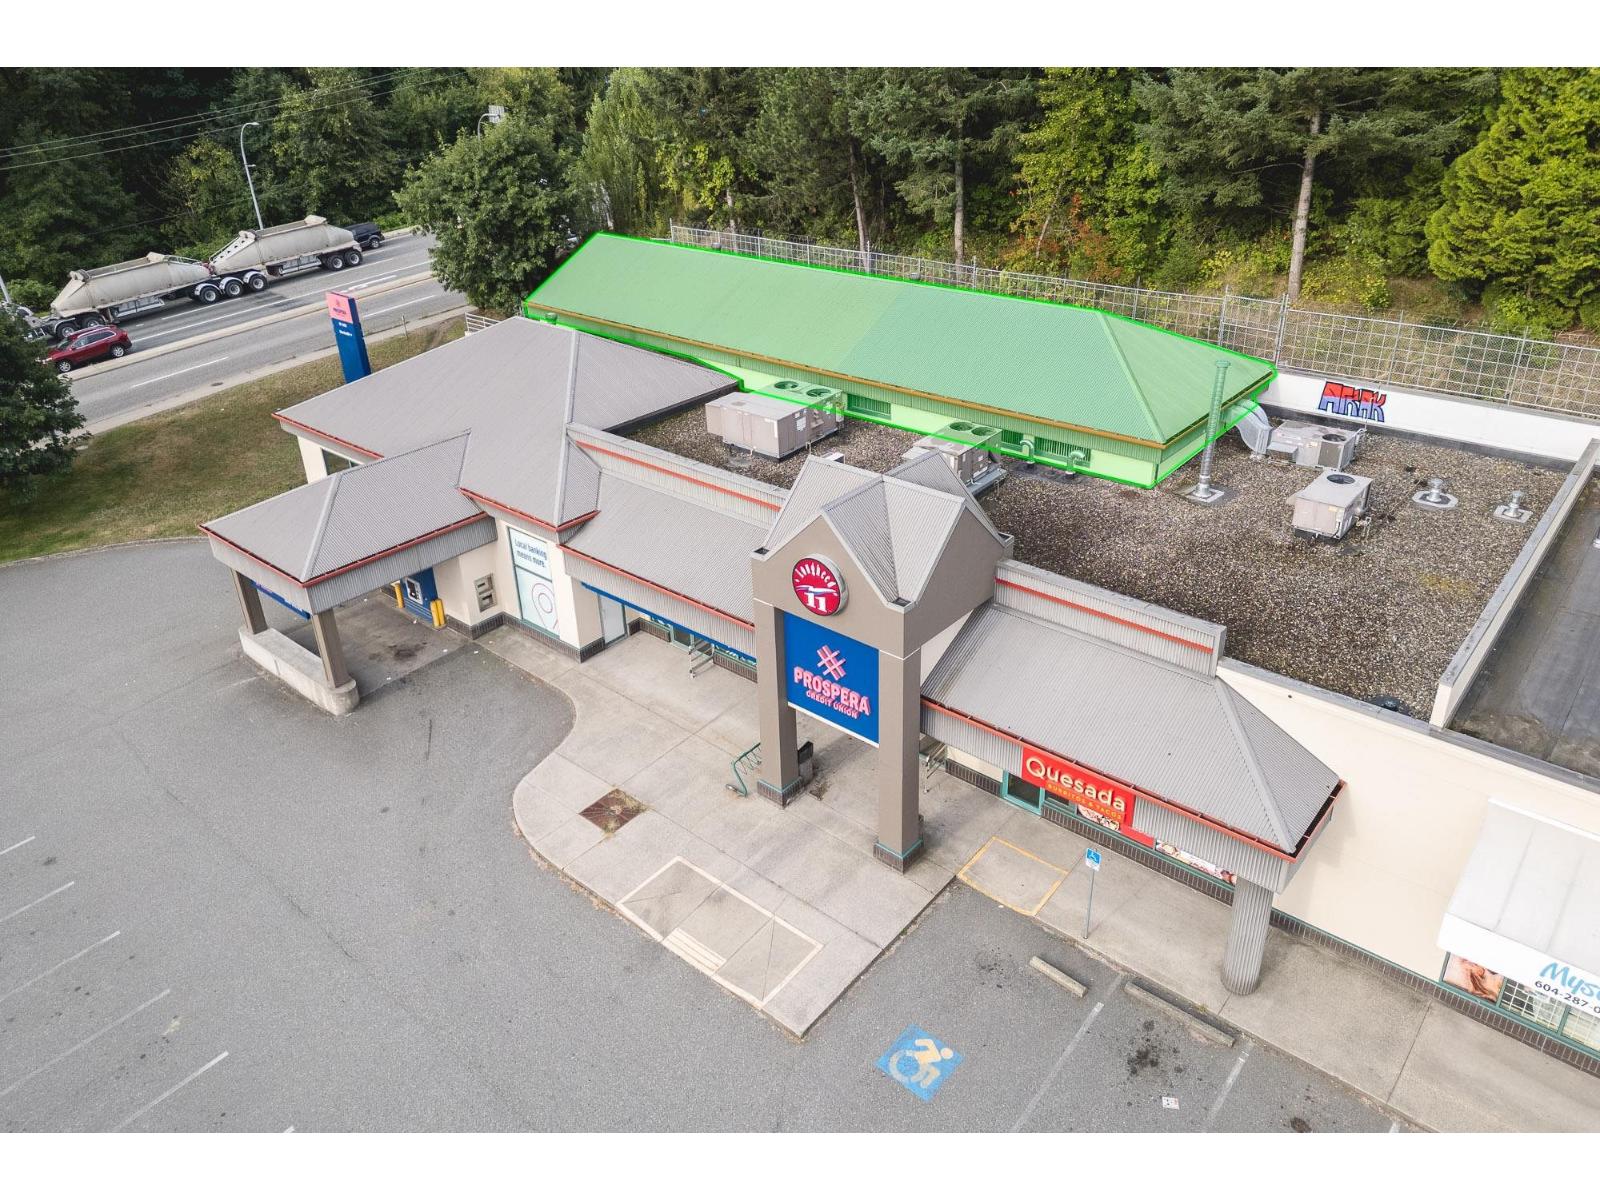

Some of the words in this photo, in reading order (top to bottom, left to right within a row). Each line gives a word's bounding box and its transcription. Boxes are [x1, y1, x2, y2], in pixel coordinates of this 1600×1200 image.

[794, 666, 871, 716] PROSPERA
[806, 689, 834, 707] CREDIT
[833, 701, 860, 719] UNION
[1026, 757, 1125, 812] Quesada
[1095, 803, 1122, 821] TACOS
